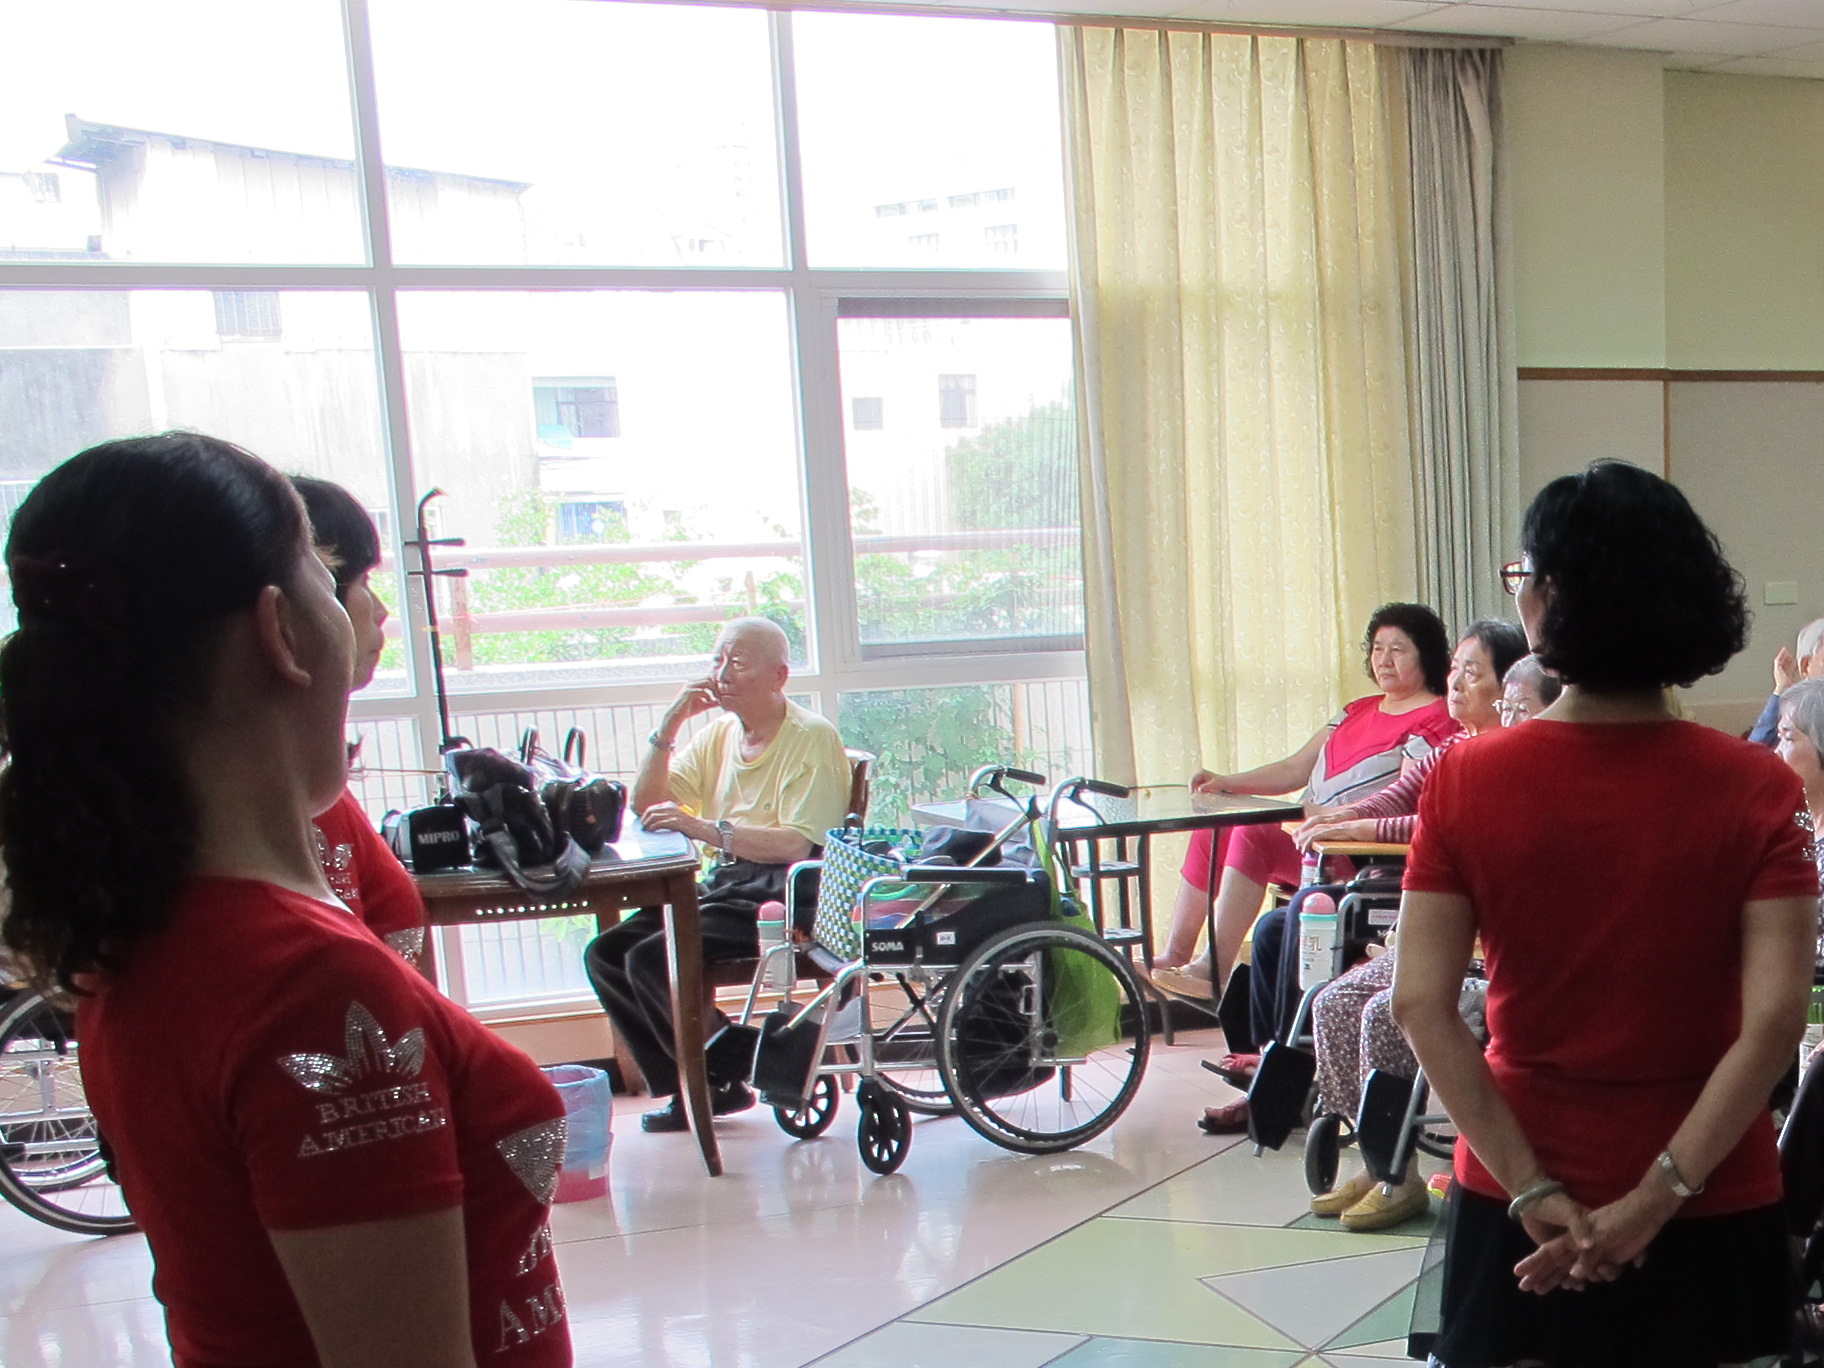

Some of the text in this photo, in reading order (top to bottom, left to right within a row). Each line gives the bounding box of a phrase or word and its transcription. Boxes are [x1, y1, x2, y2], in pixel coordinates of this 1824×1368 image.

[871, 941, 905, 952] SOMA
[315, 1081, 433, 1124] BRITISH
[297, 1107, 448, 1158] AMERICAN
